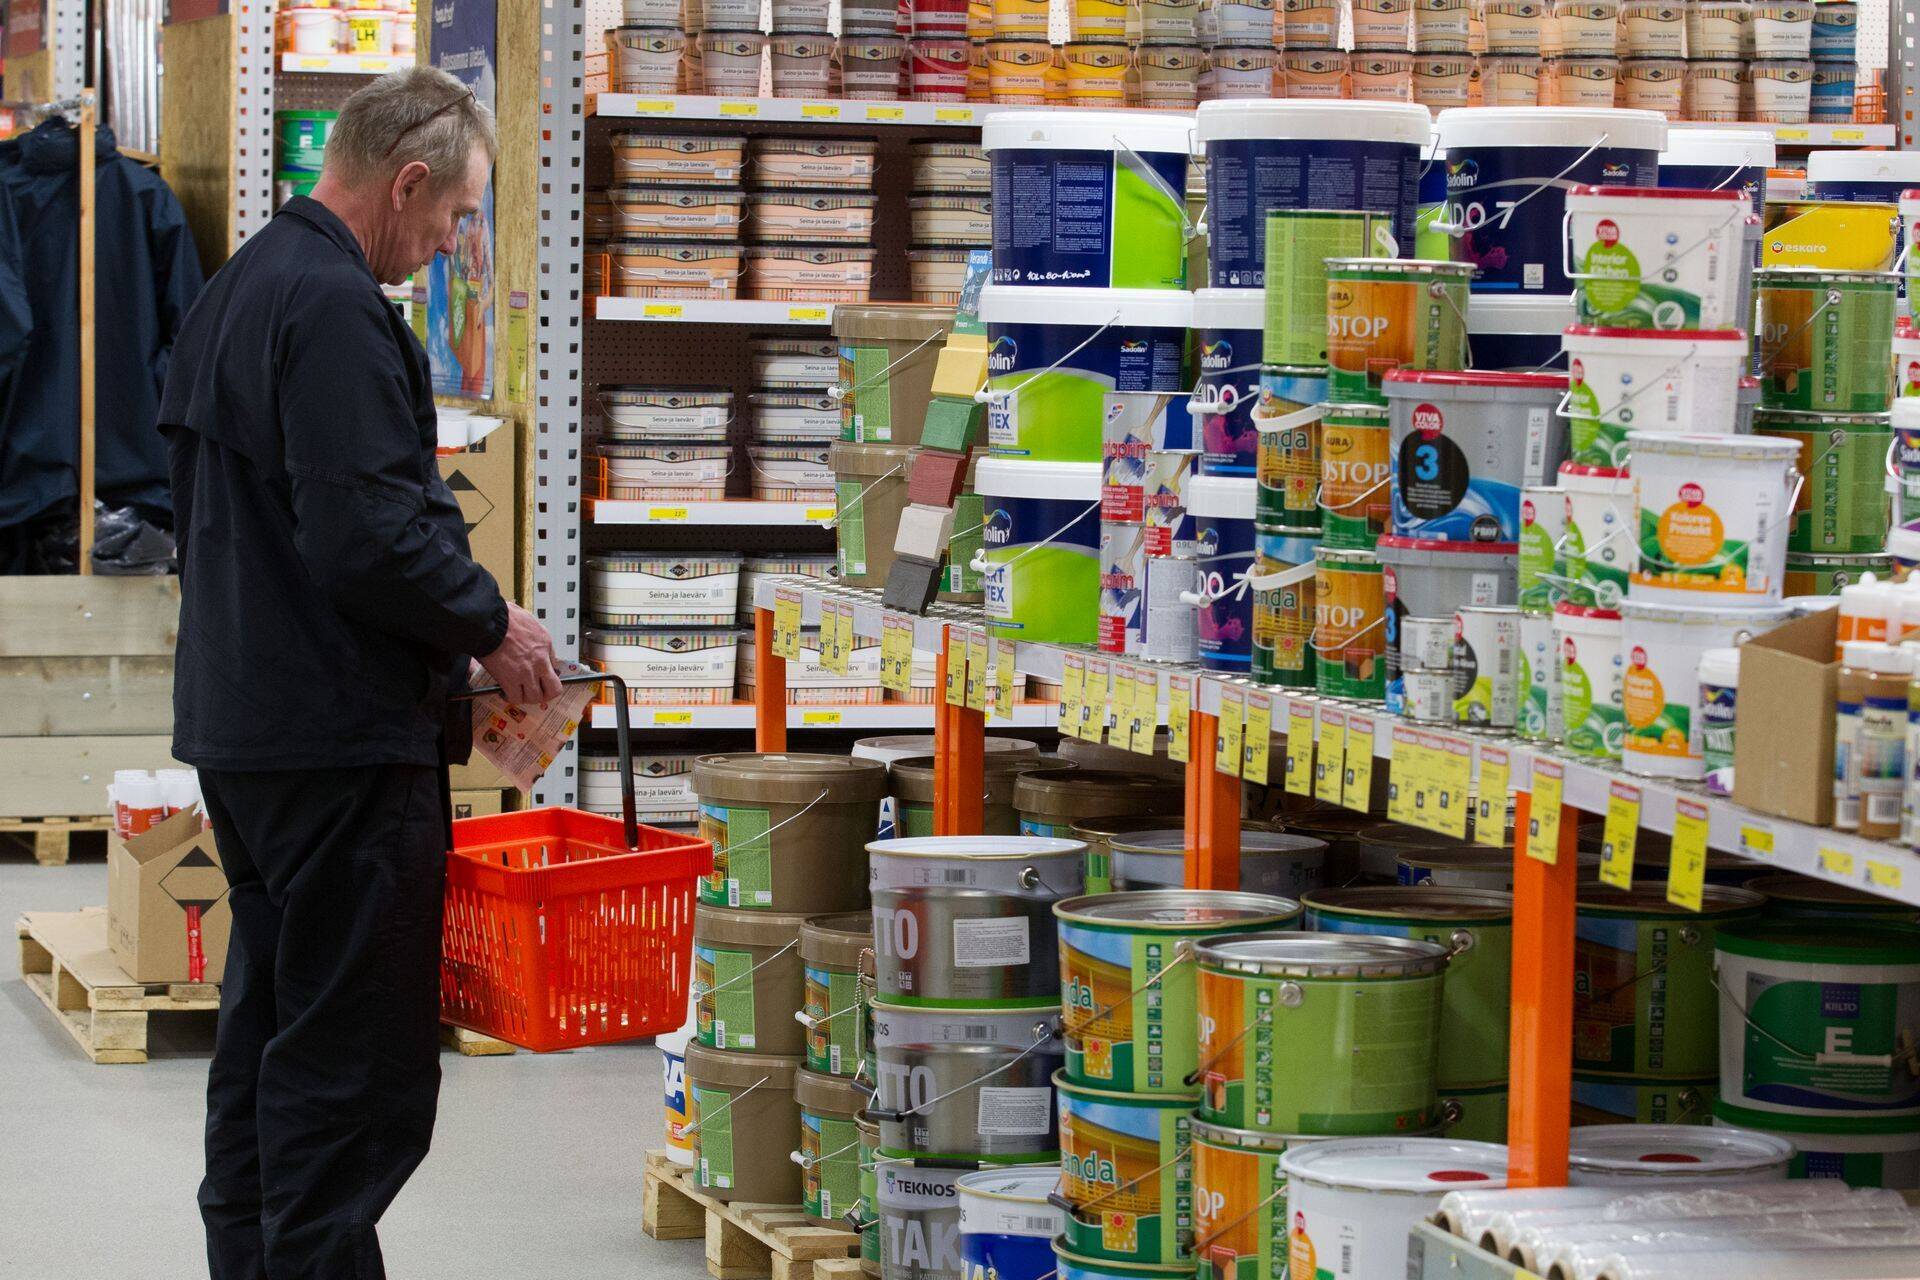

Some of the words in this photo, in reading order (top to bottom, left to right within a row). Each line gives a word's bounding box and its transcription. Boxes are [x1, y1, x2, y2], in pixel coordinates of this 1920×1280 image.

[357, 29, 376, 41] LH
[1495, 201, 1516, 230] 7
[1784, 242, 1828, 254] eskaro
[989, 413, 1010, 430] TEX
[1414, 411, 1440, 423] VIVA
[1414, 422, 1441, 430] COLOR
[1261, 428, 1308, 449] anda
[1415, 444, 1439, 481] 3
[649, 591, 678, 600] Seina-ja
[679, 590, 707, 599] laevärv
[1232, 572, 1250, 601] 7
[646, 663, 676, 674] Seina-ja
[677, 664, 704, 672] laevärv
[1824, 1002, 1858, 1012] KIILTO
[1824, 1026, 1854, 1056] E
[1062, 1151, 1115, 1184] anda
[896, 1179, 956, 1198] TEKNOS
[1196, 1186, 1225, 1220] OP
